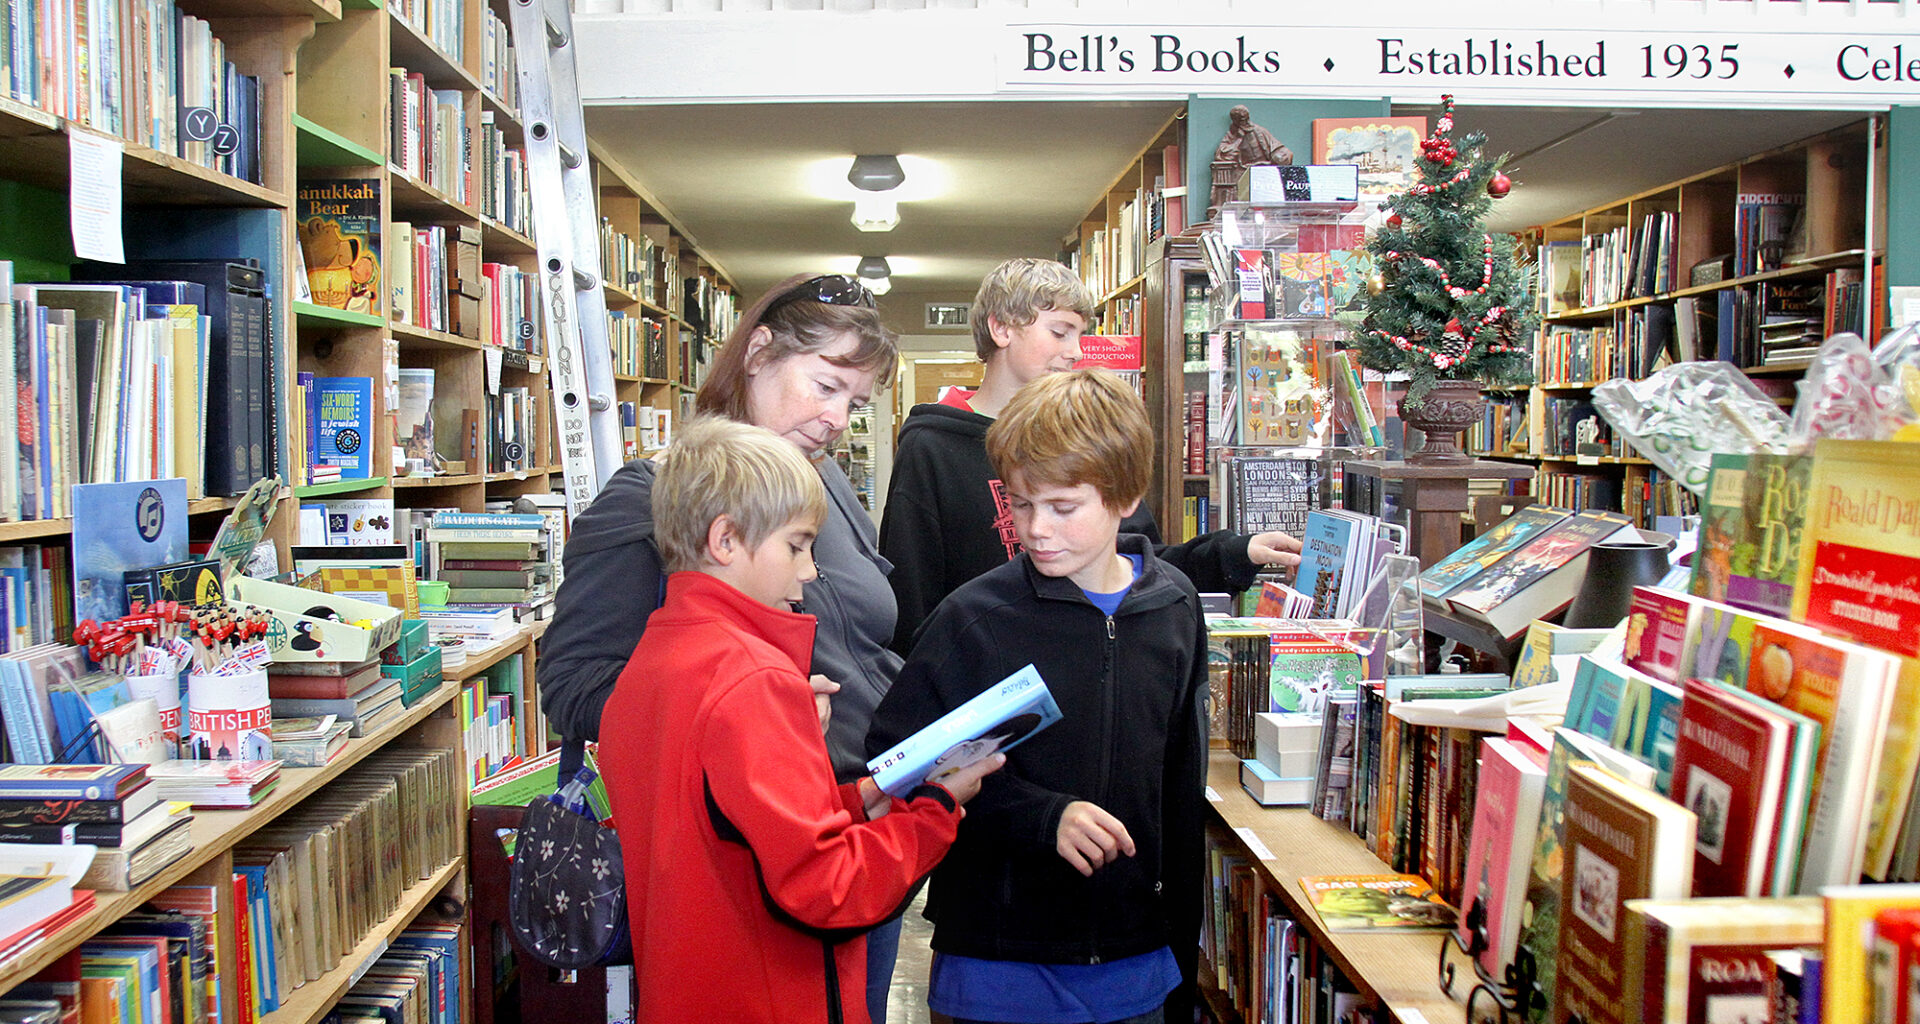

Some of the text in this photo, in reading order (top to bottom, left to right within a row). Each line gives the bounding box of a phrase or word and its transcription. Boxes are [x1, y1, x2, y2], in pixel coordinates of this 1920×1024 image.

[1022, 33, 1920, 82] Bell's Books Established 1935 Cele
[195, 115, 208, 133] Y
[217, 131, 231, 149] Z
[310, 200, 350, 215] Bear
[523, 324, 530, 336] E
[321, 393, 355, 407] SIX-WORD
[320, 407, 355, 421] MEMOIRS
[564, 419, 583, 430] DO
[511, 446, 519, 458] F
[1244, 461, 1318, 471] AMSTERDAM TOKO
[1244, 470, 1286, 480] LONDON
[573, 487, 591, 500] US
[1290, 494, 1320, 502] BERN
[1823, 485, 1882, 529] Roald
[1246, 511, 1298, 523] NEW YORK CITY
[1310, 538, 1343, 558] DESTINATION
[1315, 554, 1333, 569] MOON
[1873, 608, 1902, 632] BOOK
[189, 711, 252, 731] BRITISH
[1314, 880, 1418, 890] GAG BOOK
